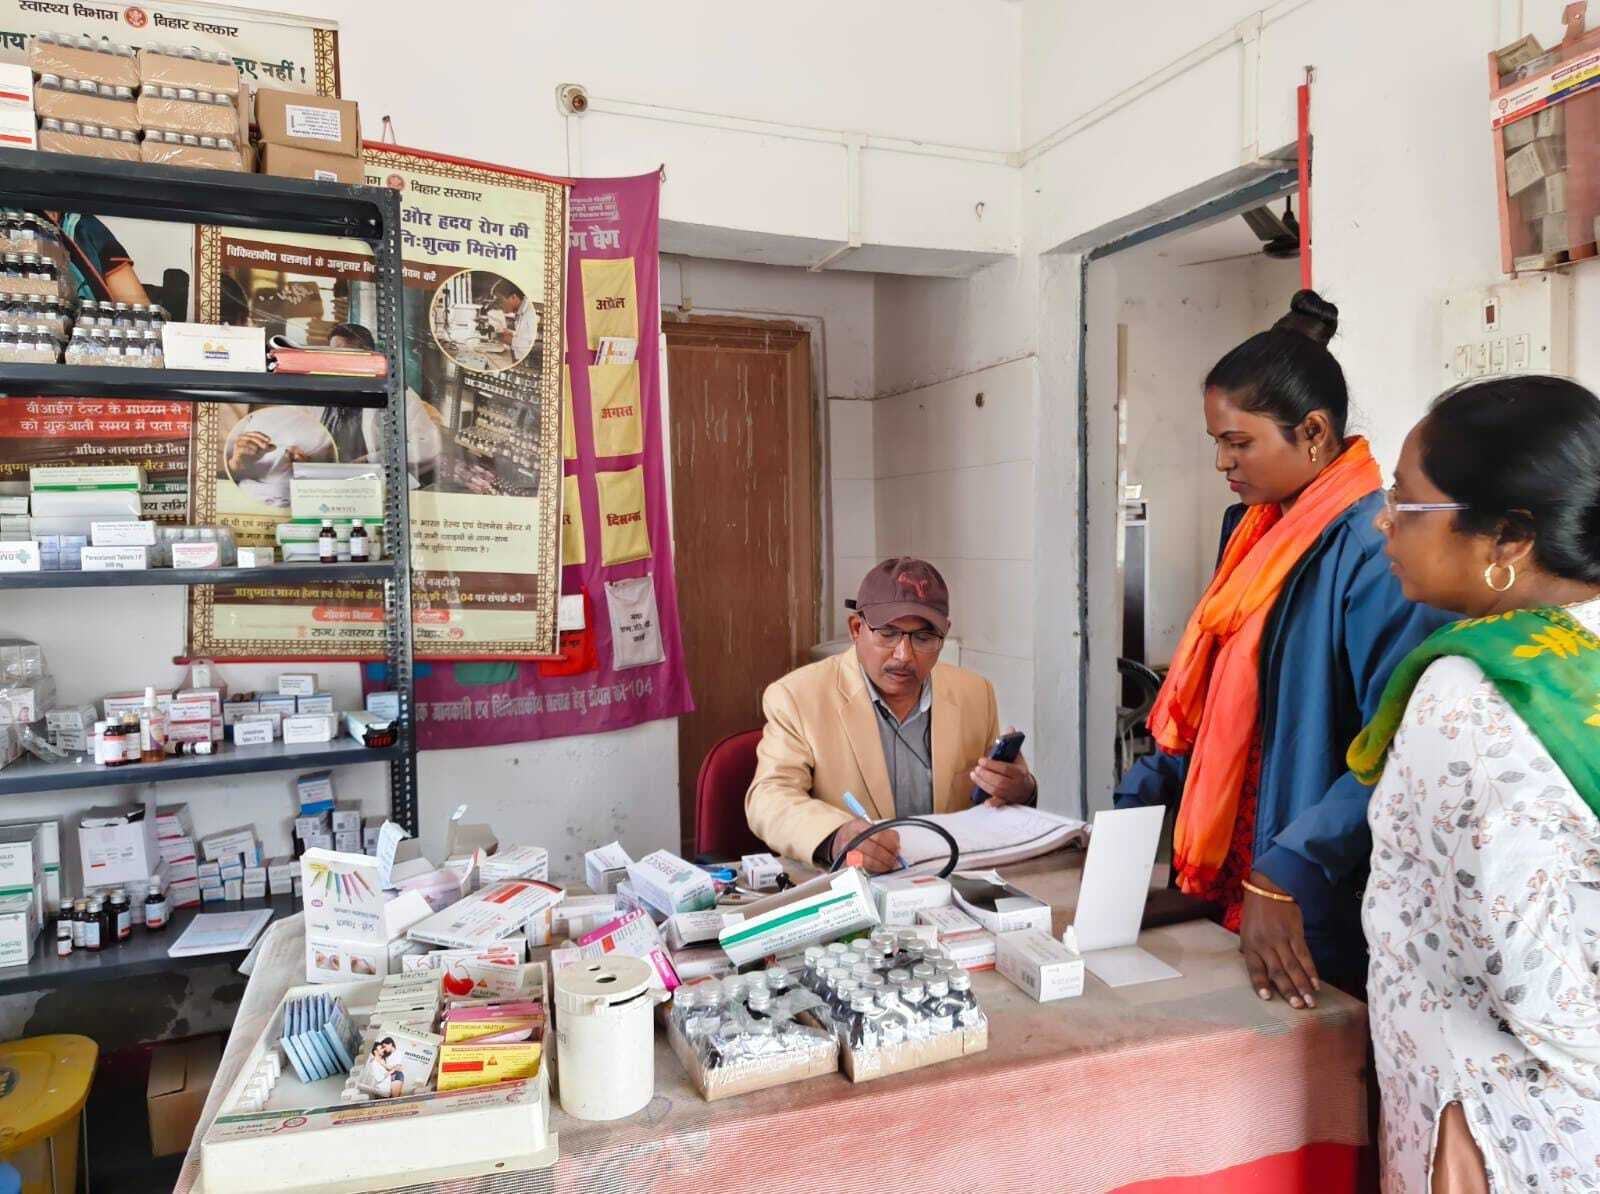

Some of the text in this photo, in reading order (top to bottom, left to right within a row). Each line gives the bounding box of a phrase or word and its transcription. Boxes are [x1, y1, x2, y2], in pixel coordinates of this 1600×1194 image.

[19, 0, 239, 38] स्वास्थ्य विभाग बिहार सरकार
[260, 60, 295, 82] नहीं
[411, 180, 482, 203] बिहार सरकार
[402, 206, 530, 239] और हृदय रोग की
[588, 224, 621, 250] बैग
[227, 244, 277, 263] चिकित्सकीय
[315, 254, 324, 267] के
[467, 236, 518, 262] मिलेंगी
[596, 296, 626, 311] अप्रैल
[109, 402, 121, 415] के
[170, 401, 183, 415] से
[600, 405, 634, 420] अगस्त
[21, 418, 38, 432] को
[99, 420, 130, 432] समय
[135, 418, 145, 432] में
[149, 420, 173, 432] पता
[153, 443, 165, 455] के
[166, 442, 187, 455] लिए
